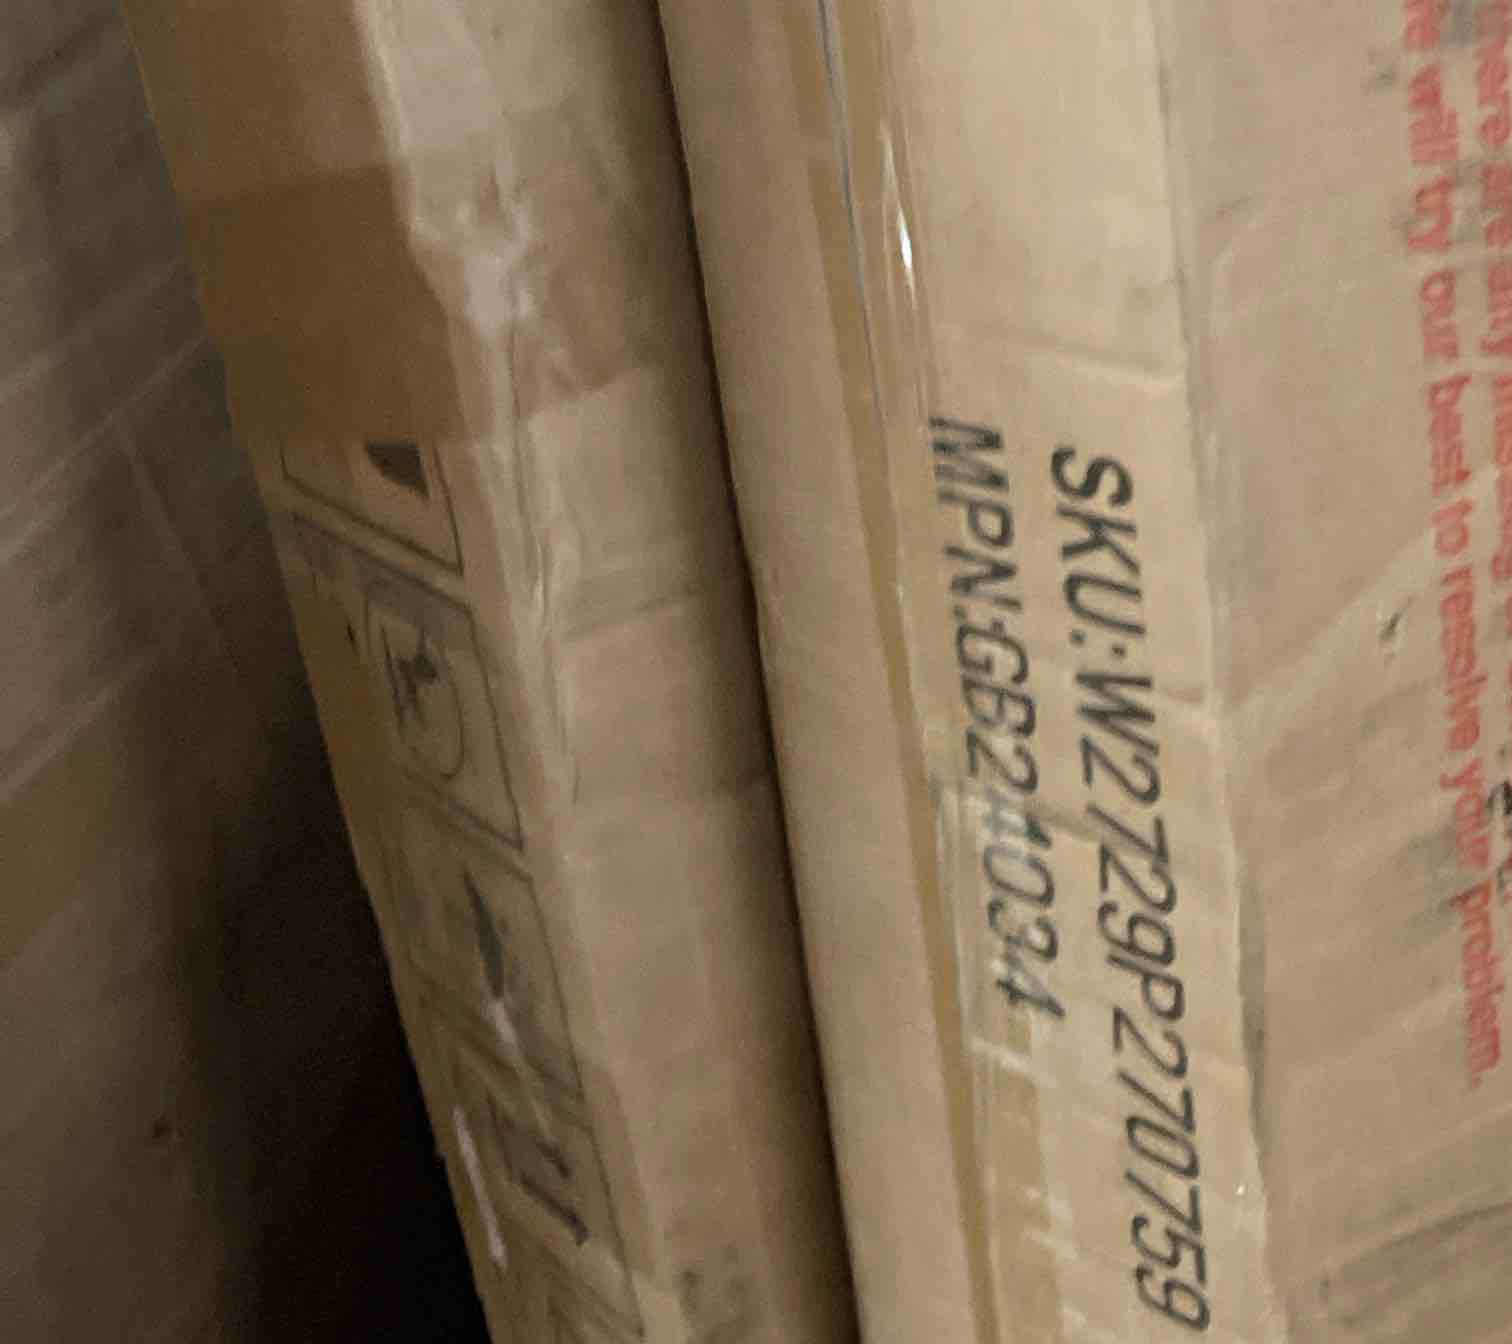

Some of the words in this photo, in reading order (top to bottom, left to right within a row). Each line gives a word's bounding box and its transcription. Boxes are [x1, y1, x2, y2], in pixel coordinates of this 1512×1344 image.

[1407, 61, 1460, 166] will
[1418, 268, 1460, 360] our
[1427, 372, 1473, 497] best
[1050, 445, 1211, 1334] SKU:W2729P270759
